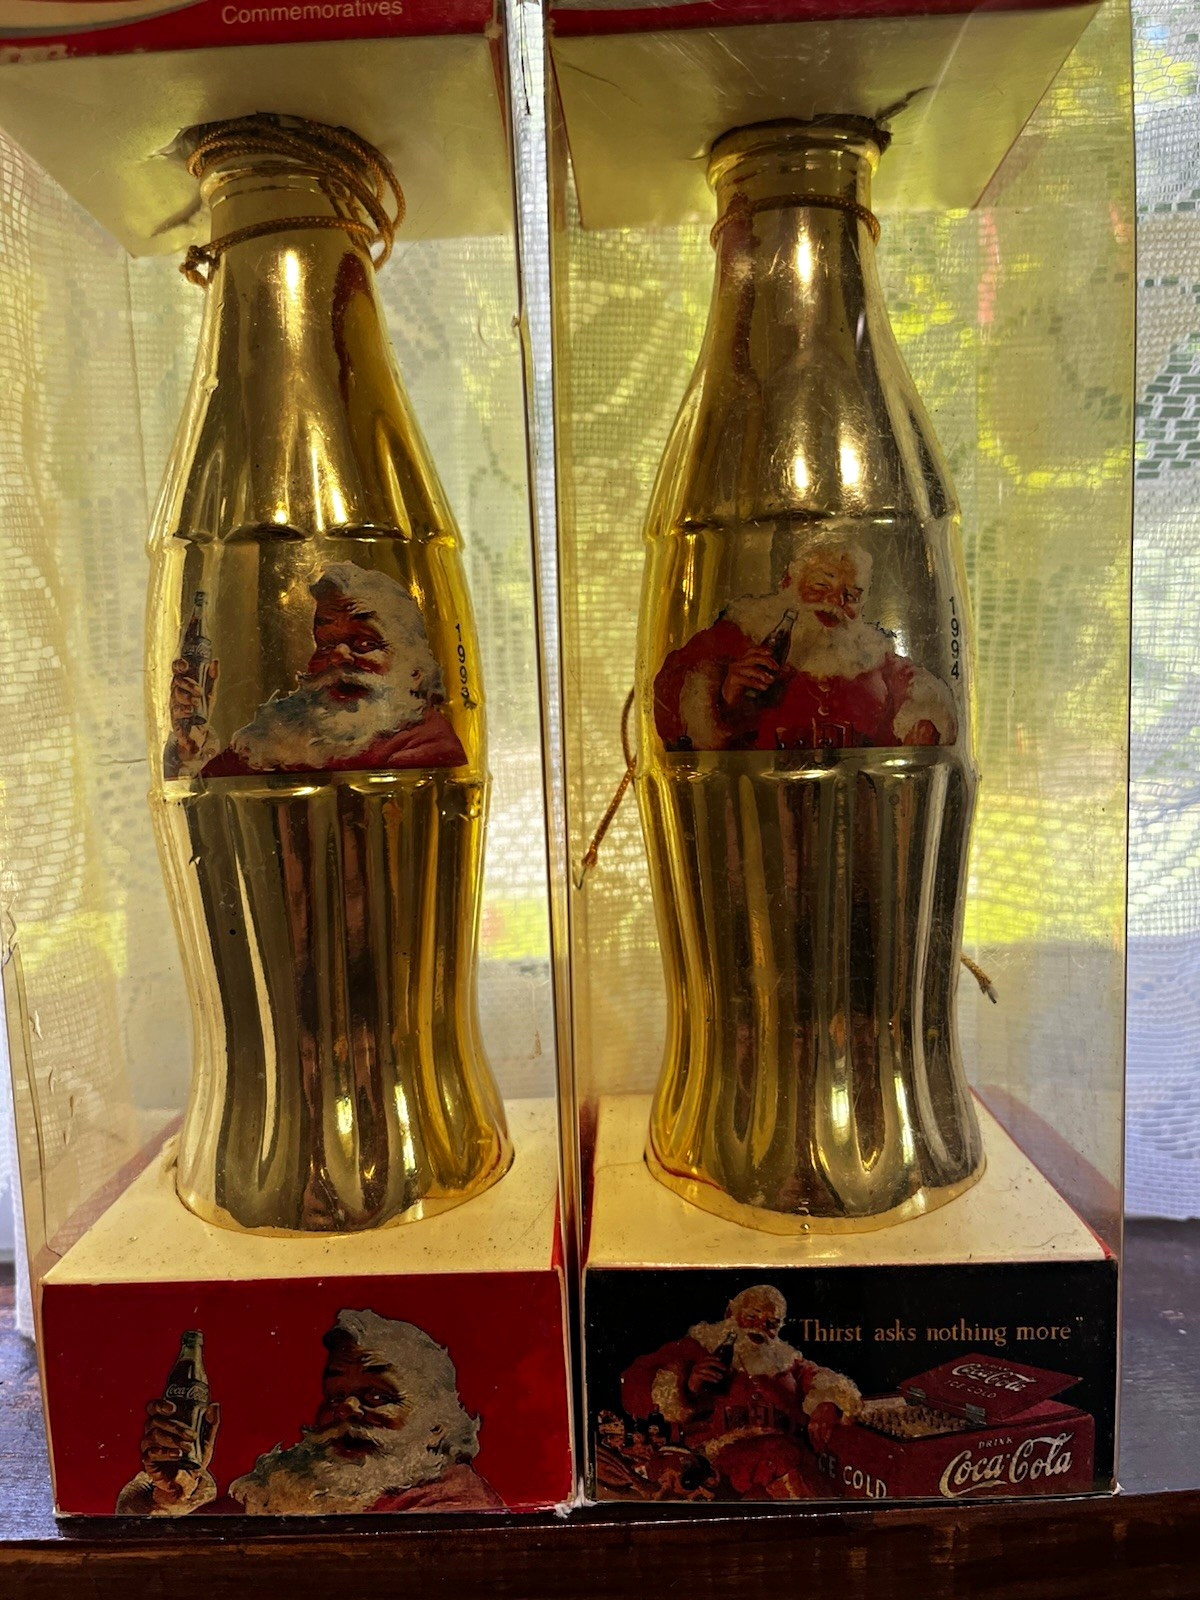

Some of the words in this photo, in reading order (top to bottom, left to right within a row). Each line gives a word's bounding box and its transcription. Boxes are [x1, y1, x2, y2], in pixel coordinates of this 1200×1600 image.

[221, 0, 404, 25] Commemoratives
[948, 596, 960, 680] 1994
[455, 623, 470, 700] 1993
[874, 1318, 917, 1342] asks
[926, 1317, 1008, 1347] nothing
[978, 1436, 1014, 1450] DRINK
[842, 1465, 888, 1498] COLD
[938, 1431, 1076, 1499] Coca-Cola
